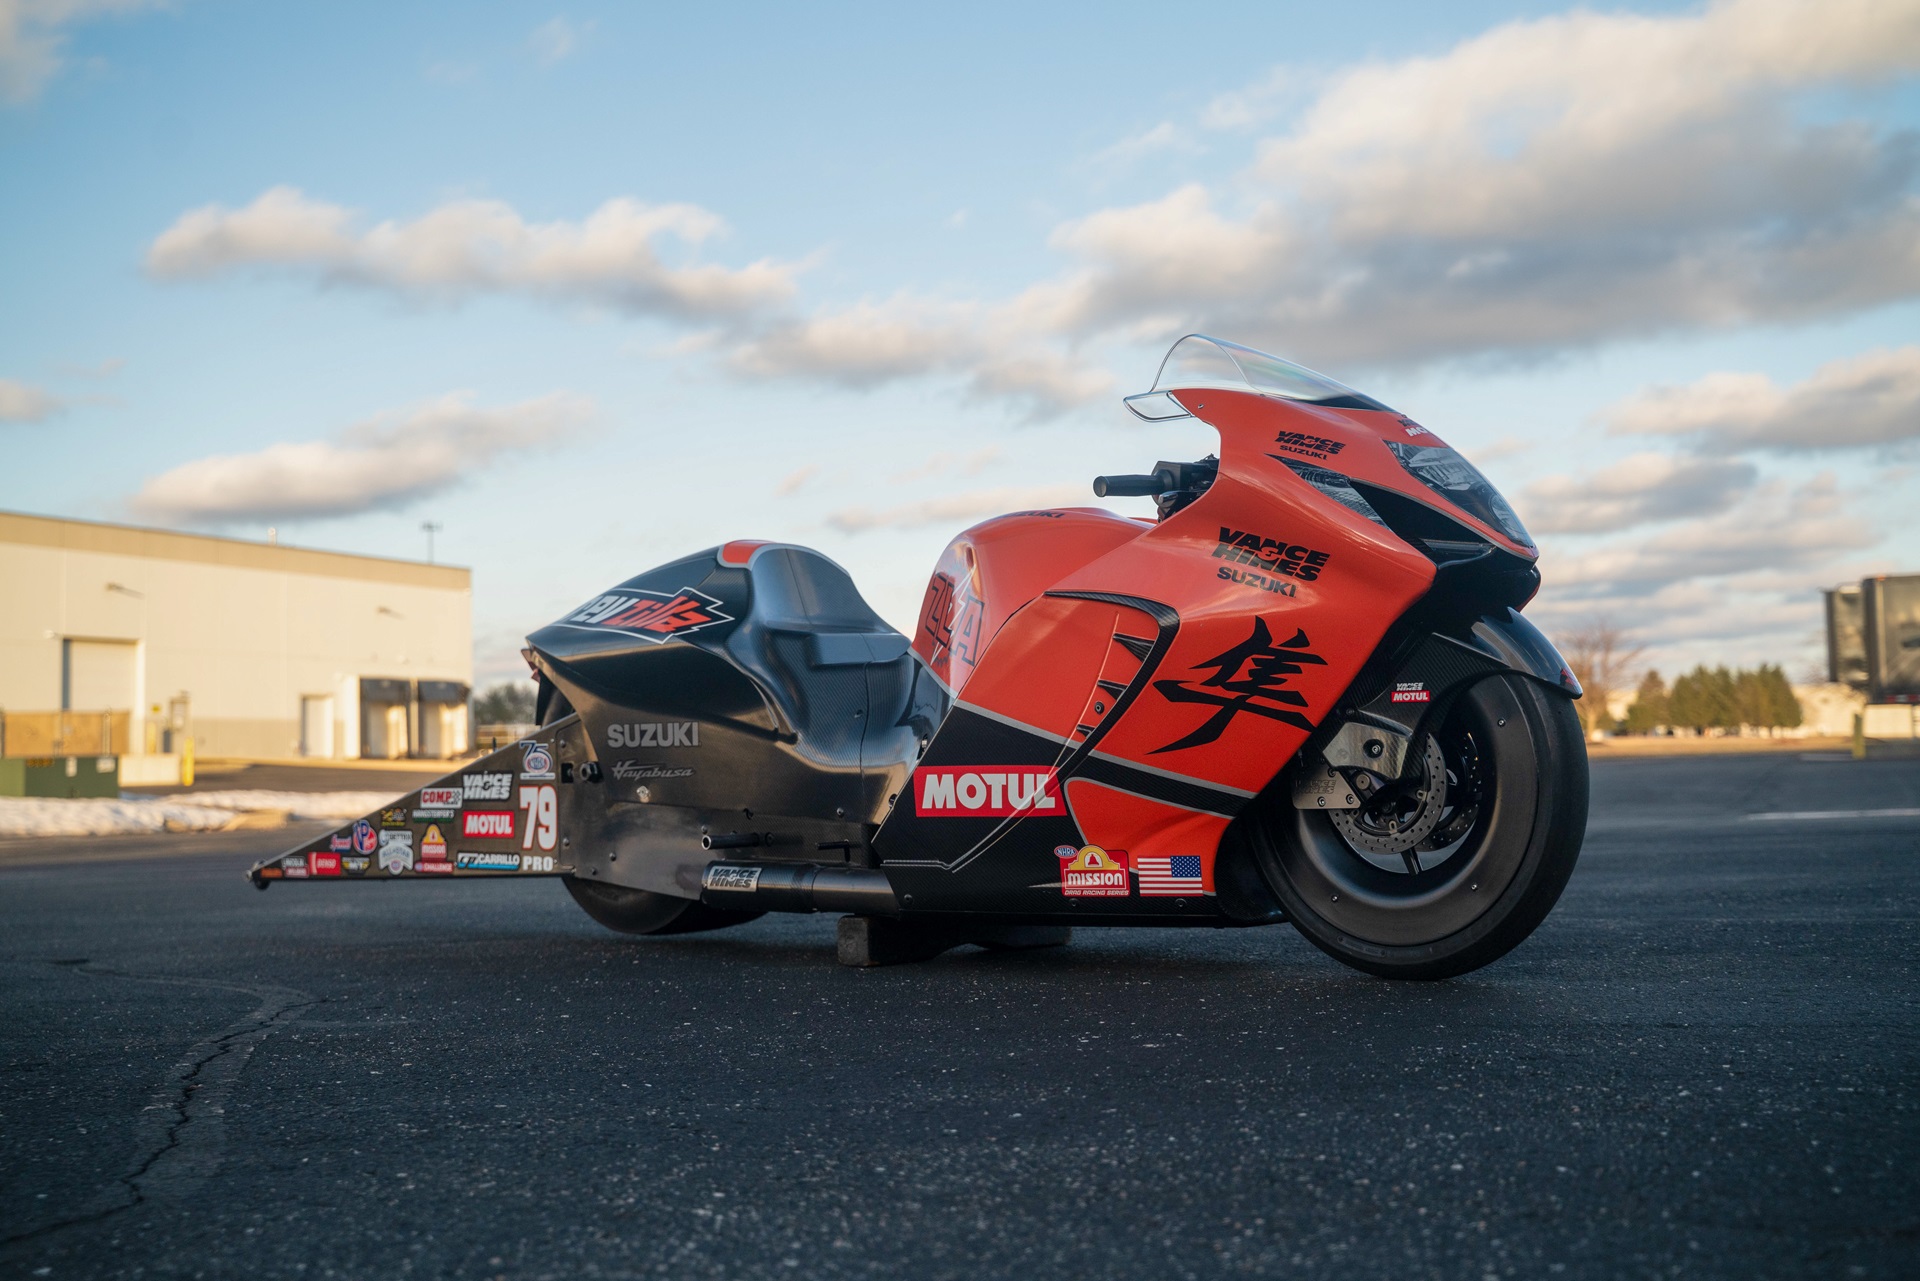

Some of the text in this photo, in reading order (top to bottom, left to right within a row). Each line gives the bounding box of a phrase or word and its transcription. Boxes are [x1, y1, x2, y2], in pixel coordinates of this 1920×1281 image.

[1275, 437, 1340, 455] HINES
[1279, 430, 1346, 450] VANCE
[1280, 445, 1327, 460] SUZUKI
[1218, 526, 1330, 567] VANCE
[1211, 543, 1321, 581] HINES
[1217, 566, 1297, 598] SUZUKI
[1393, 692, 1428, 701] MOTUL
[607, 722, 699, 748] SUZUKI
[611, 760, 695, 781] Hayabusa
[463, 773, 512, 787] VANCE
[422, 791, 452, 803] COMP
[463, 786, 510, 799] HINES
[922, 773, 1056, 810] MOTUL
[465, 815, 512, 835] MOTUL
[519, 784, 558, 851] 79
[523, 856, 553, 871] PRO
[713, 868, 758, 878] VANCE
[1067, 873, 1123, 886] MISSION
[709, 878, 752, 888] HINES
